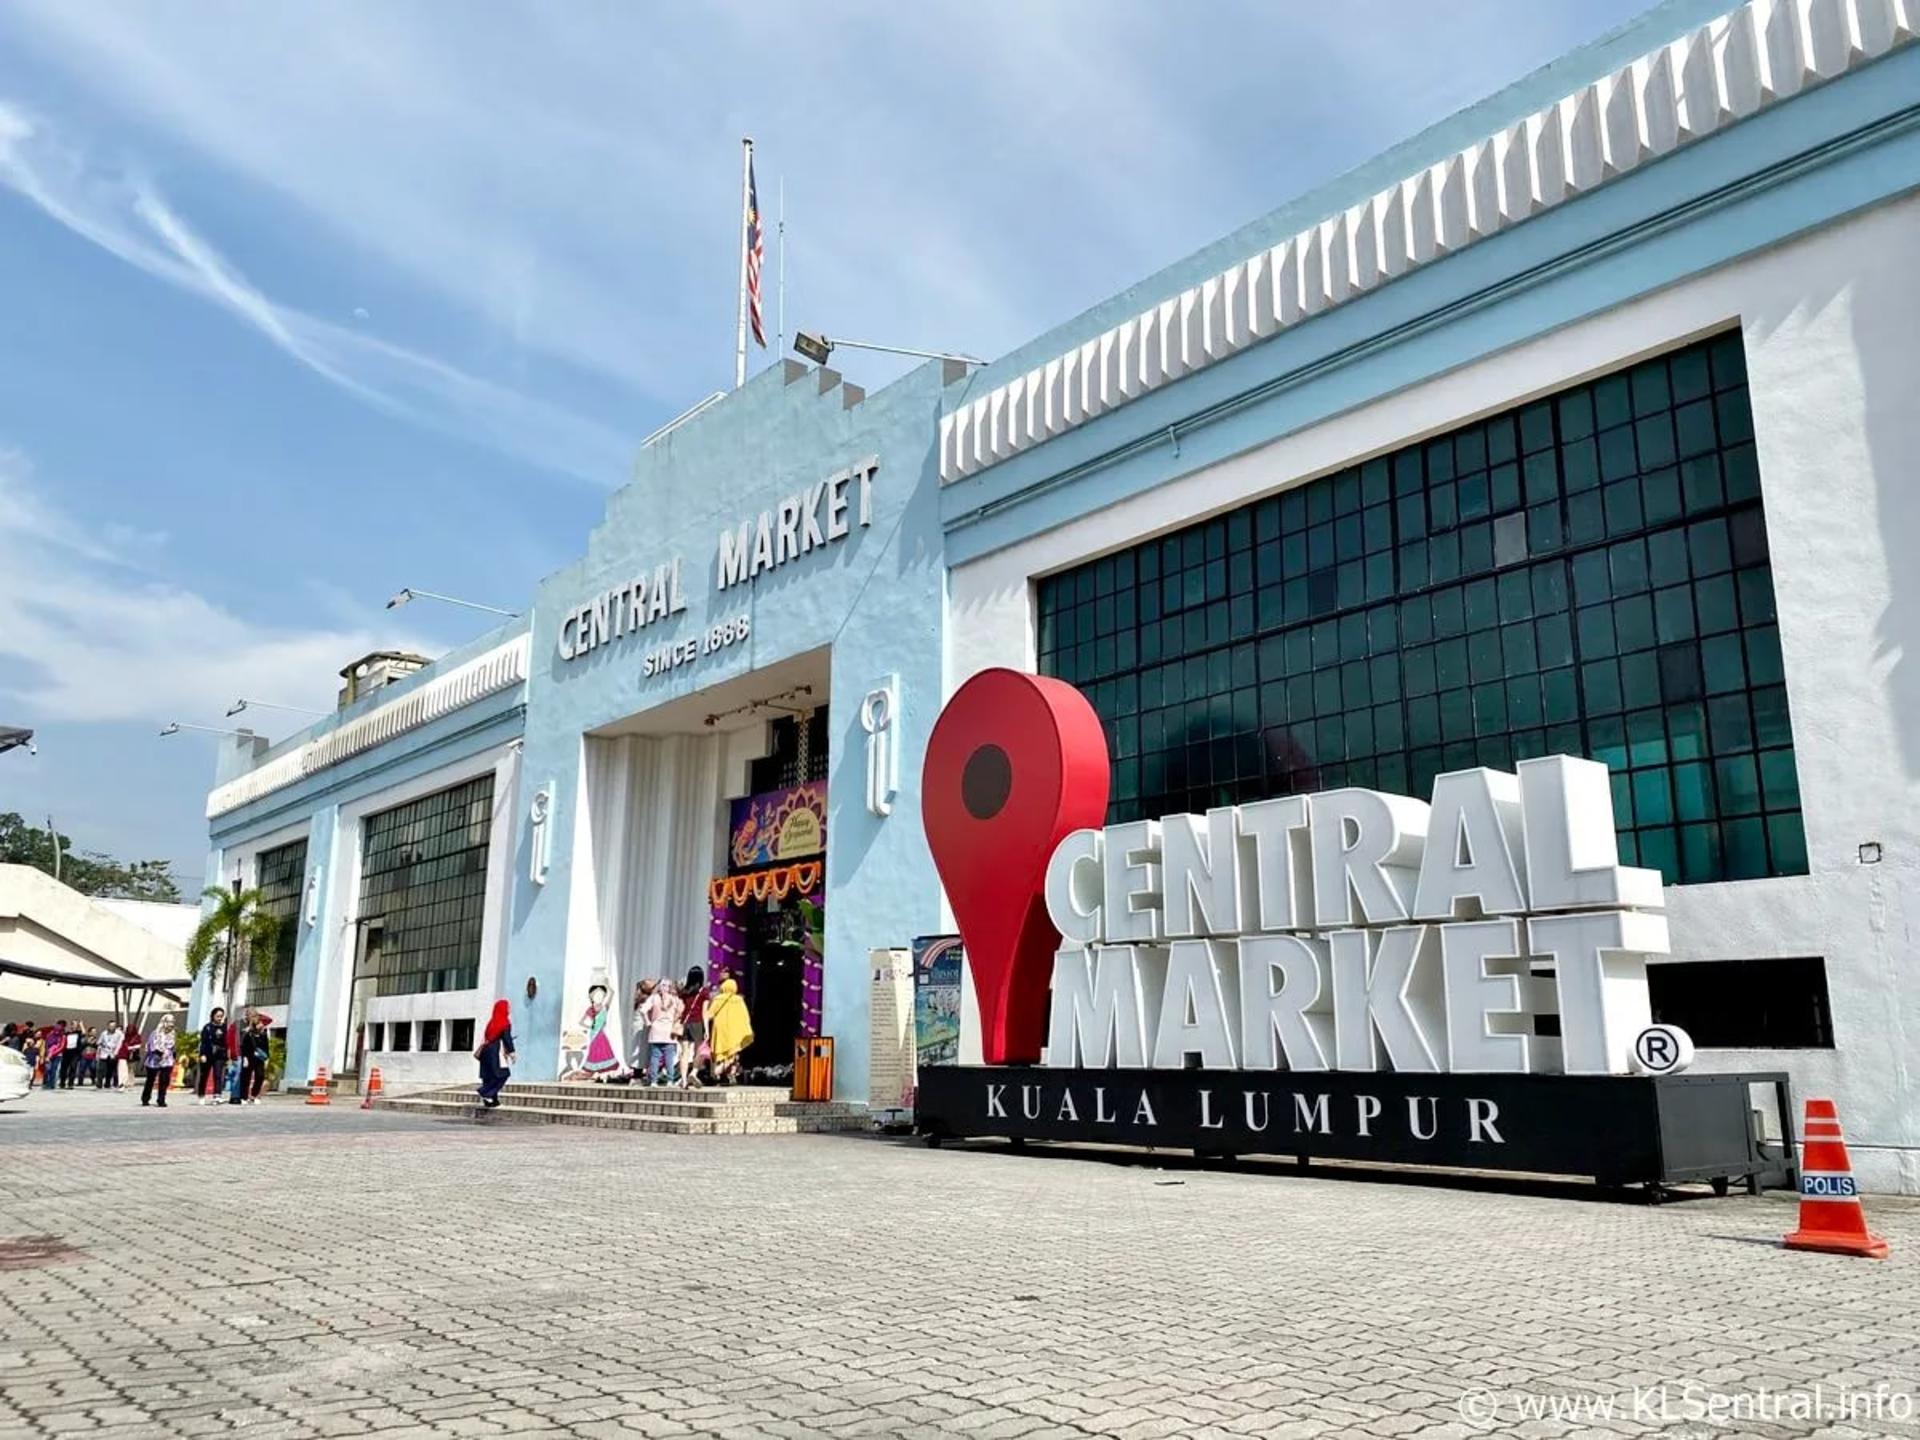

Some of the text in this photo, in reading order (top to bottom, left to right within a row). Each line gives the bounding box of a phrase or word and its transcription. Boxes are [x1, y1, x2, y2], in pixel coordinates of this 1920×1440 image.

[558, 455, 879, 661] CENTRAL MARKET
[643, 614, 750, 678] SINCE 1888
[1045, 754, 1664, 944] CENTRAL
[1047, 910, 1670, 1075] MARKET
[986, 1084, 1506, 1145] KUALA LUMPUR
[1804, 1177, 1853, 1195] POLIS
